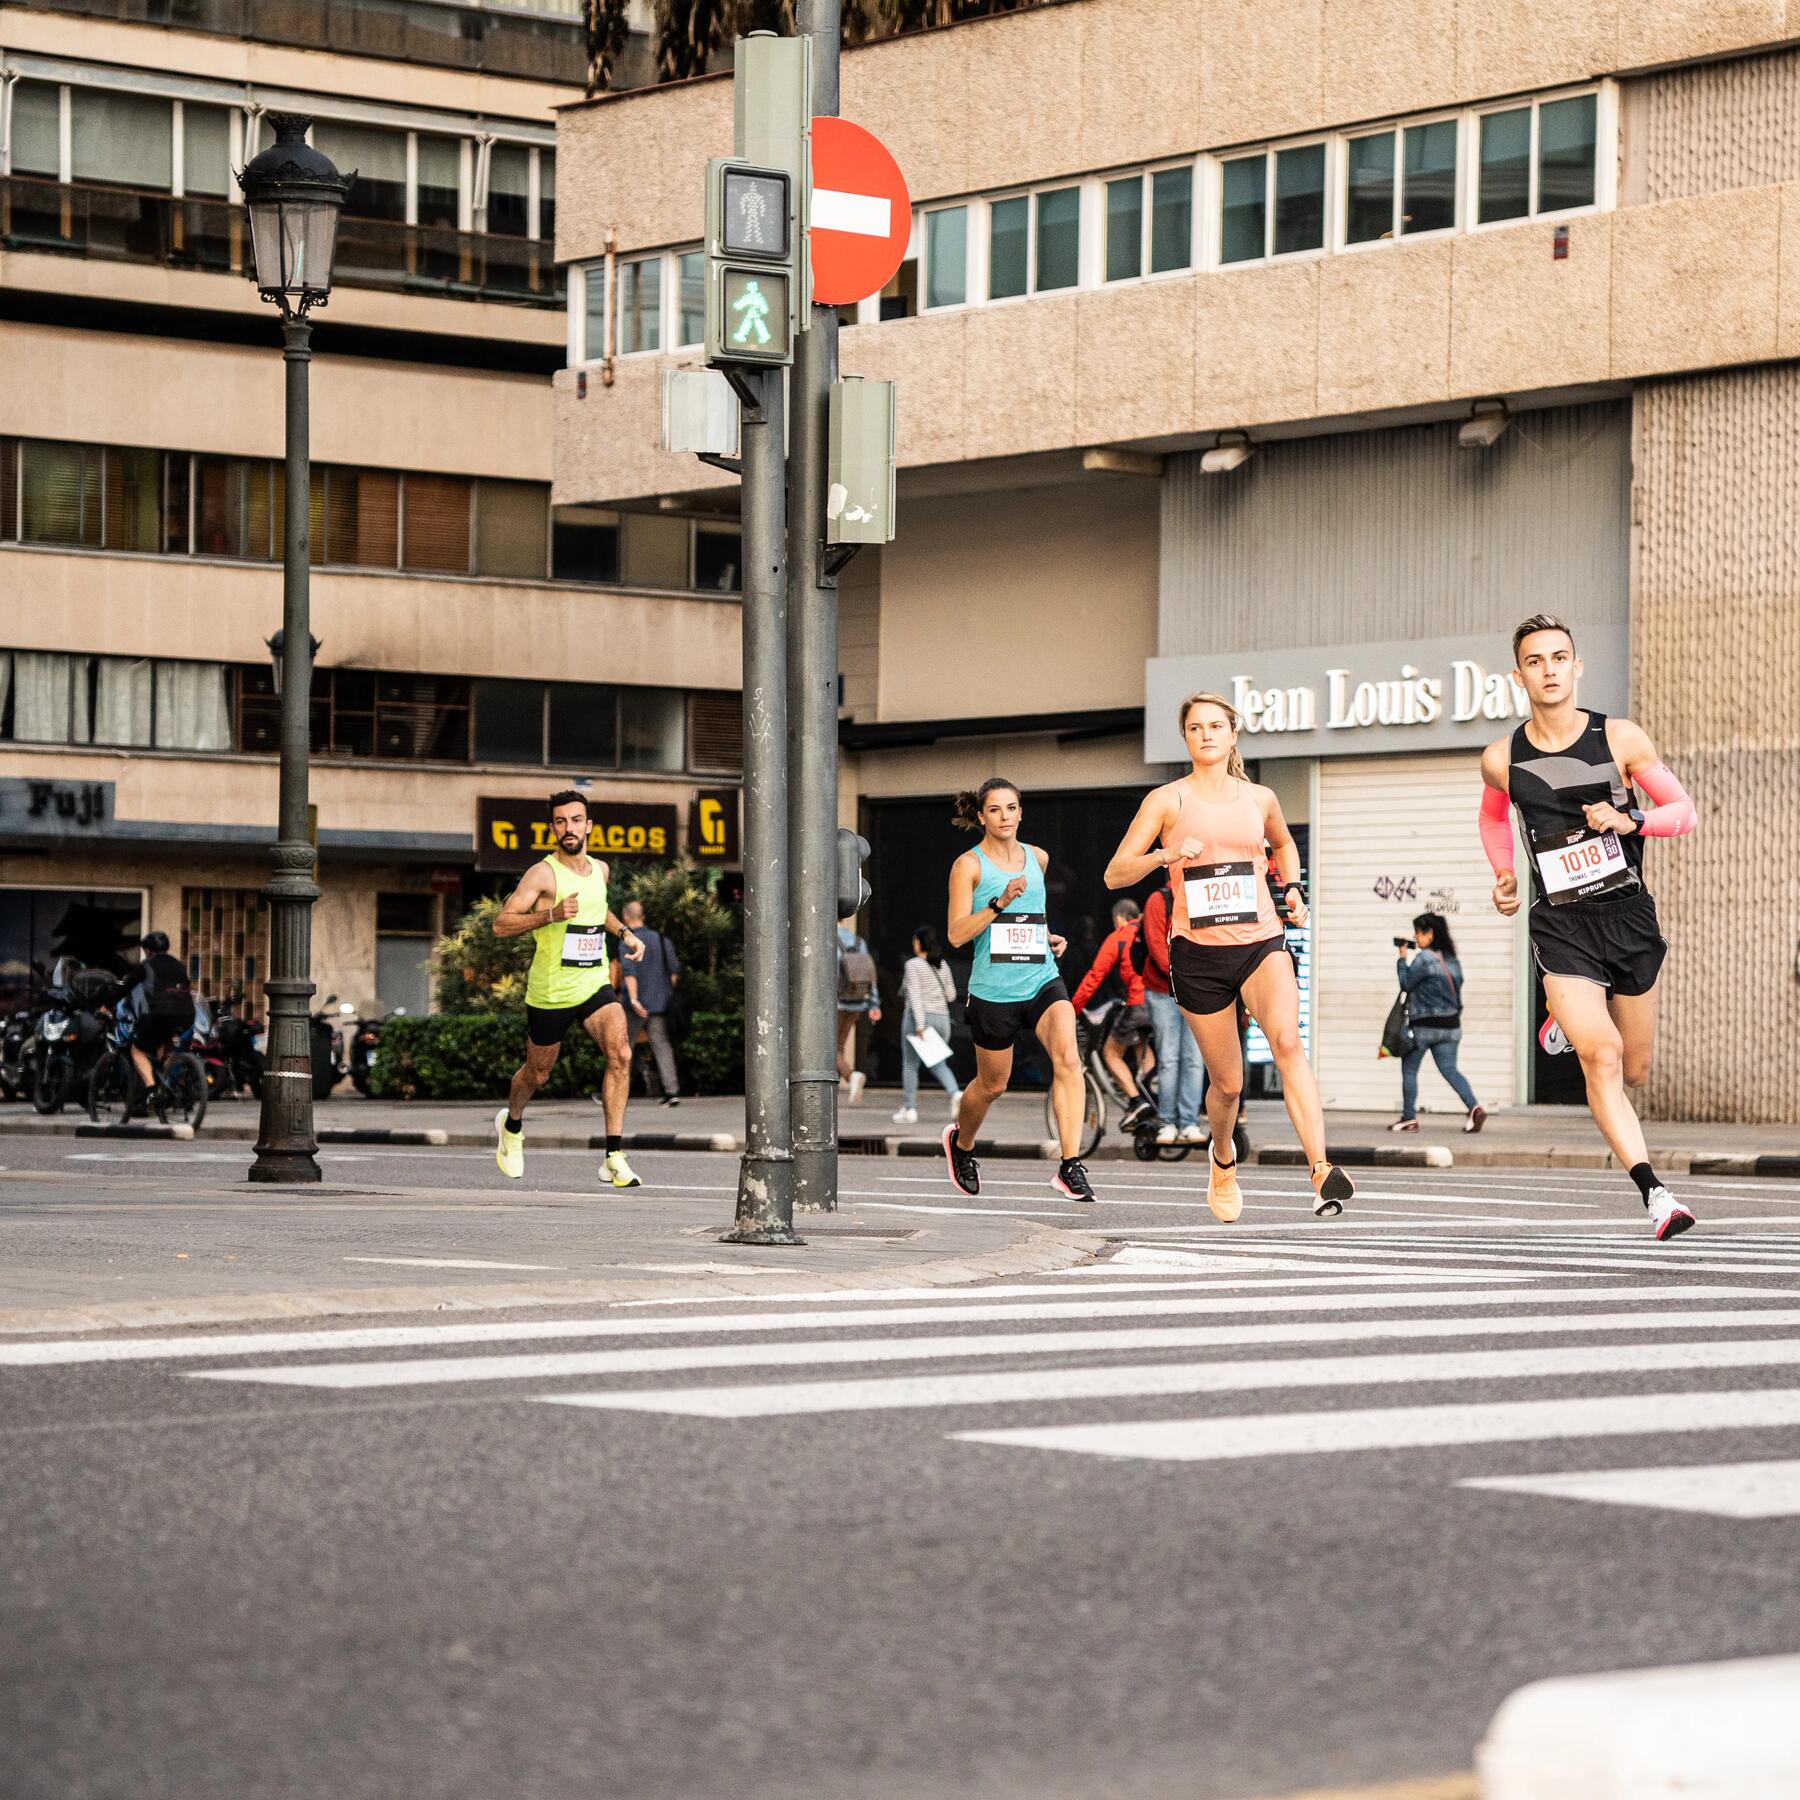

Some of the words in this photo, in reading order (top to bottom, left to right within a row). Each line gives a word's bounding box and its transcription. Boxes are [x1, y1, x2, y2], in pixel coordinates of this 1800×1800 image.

[1231, 675, 1317, 733] Jean
[1325, 664, 1442, 729] Louis
[1451, 660, 1530, 722] Dav
[531, 822, 666, 849] TACOS
[1603, 835, 1616, 847] 2H
[1607, 845, 1618, 857] 30
[1559, 845, 1601, 873] 1018
[1204, 881, 1240, 902] 1204
[1578, 882, 1604, 895] KIPRUN
[1214, 915, 1239, 924] KIPRUN
[1006, 928, 1033, 943] 1597
